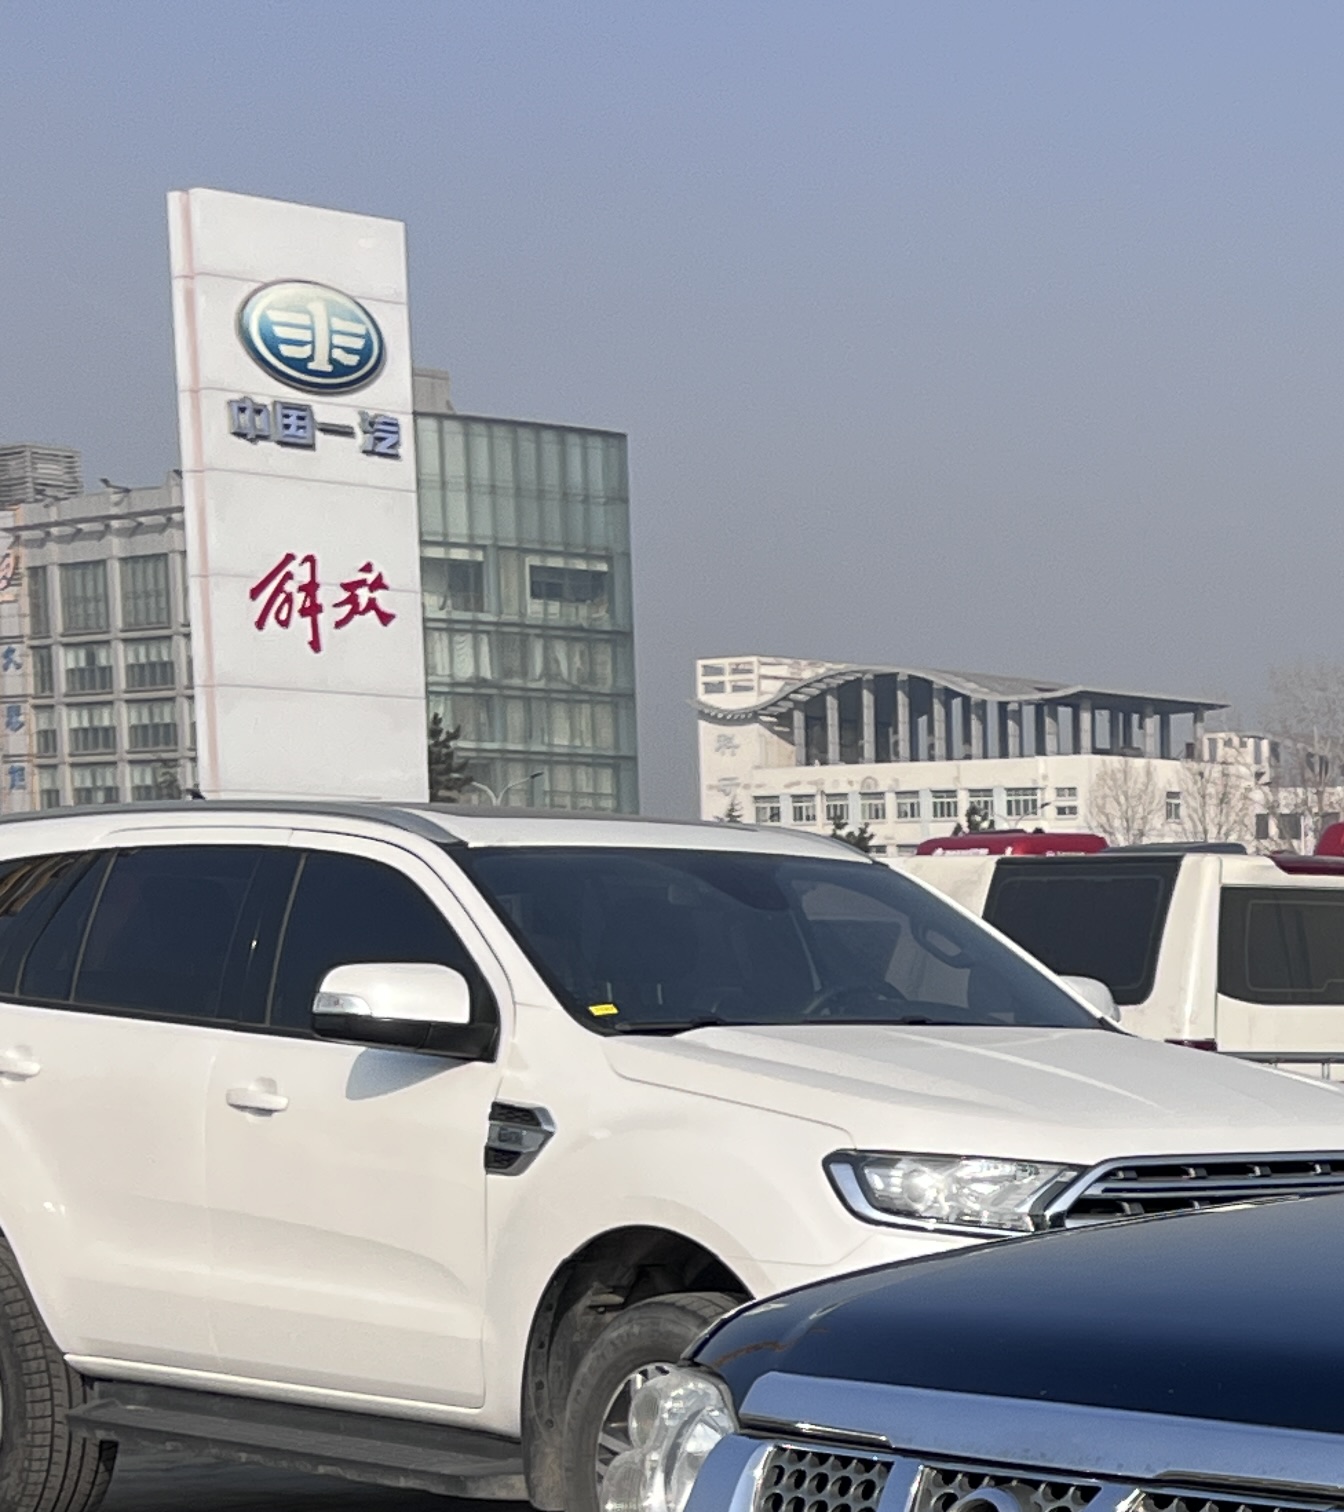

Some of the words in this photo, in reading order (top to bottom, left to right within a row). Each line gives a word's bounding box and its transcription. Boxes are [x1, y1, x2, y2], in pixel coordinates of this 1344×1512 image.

[227, 396, 401, 461] 中国一汽
[249, 552, 396, 653] 解放
